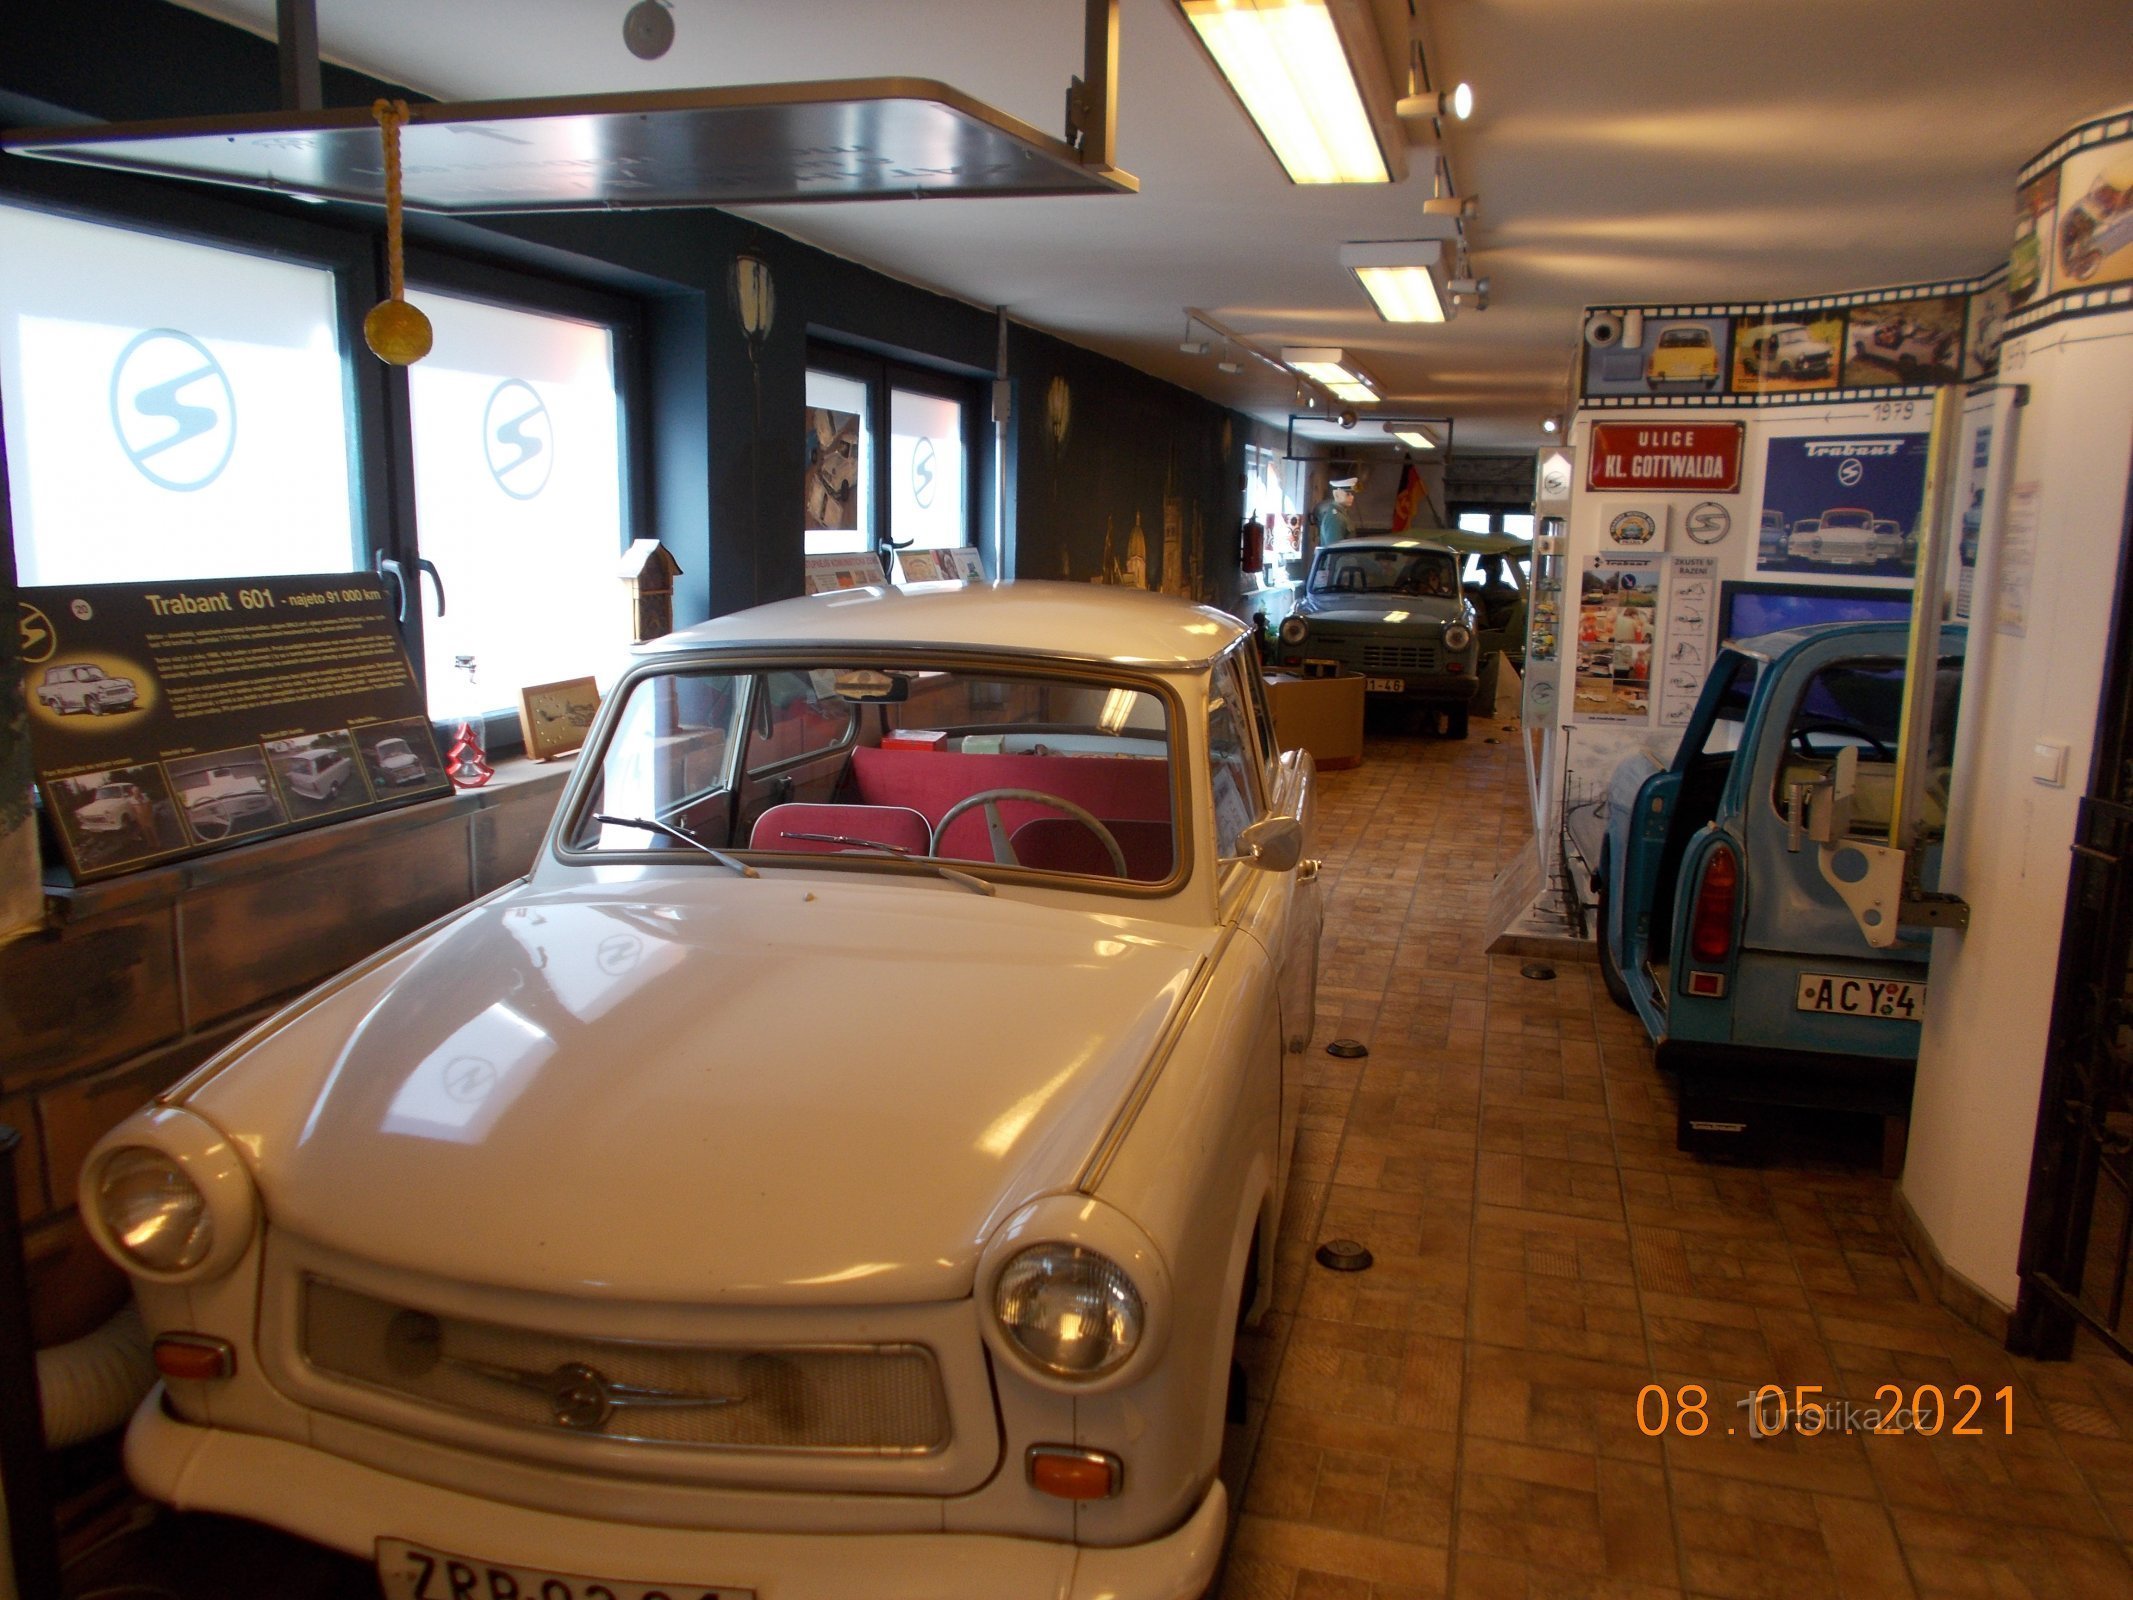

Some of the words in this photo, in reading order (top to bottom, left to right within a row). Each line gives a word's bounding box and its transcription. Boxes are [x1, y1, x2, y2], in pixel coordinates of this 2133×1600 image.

[1638, 431, 1695, 447] ULICE
[1804, 440, 1905, 457] Trabant
[1605, 454, 1627, 478] KL.
[1632, 454, 1724, 479] GOTTWALDA
[144, 592, 233, 616] Trabant
[239, 588, 275, 609] 601
[288, 593, 326, 608] najeto
[326, 591, 341, 604] 91
[342, 590, 361, 602] 000
[363, 589, 382, 601] km
[1814, 979, 1884, 1014] ACY
